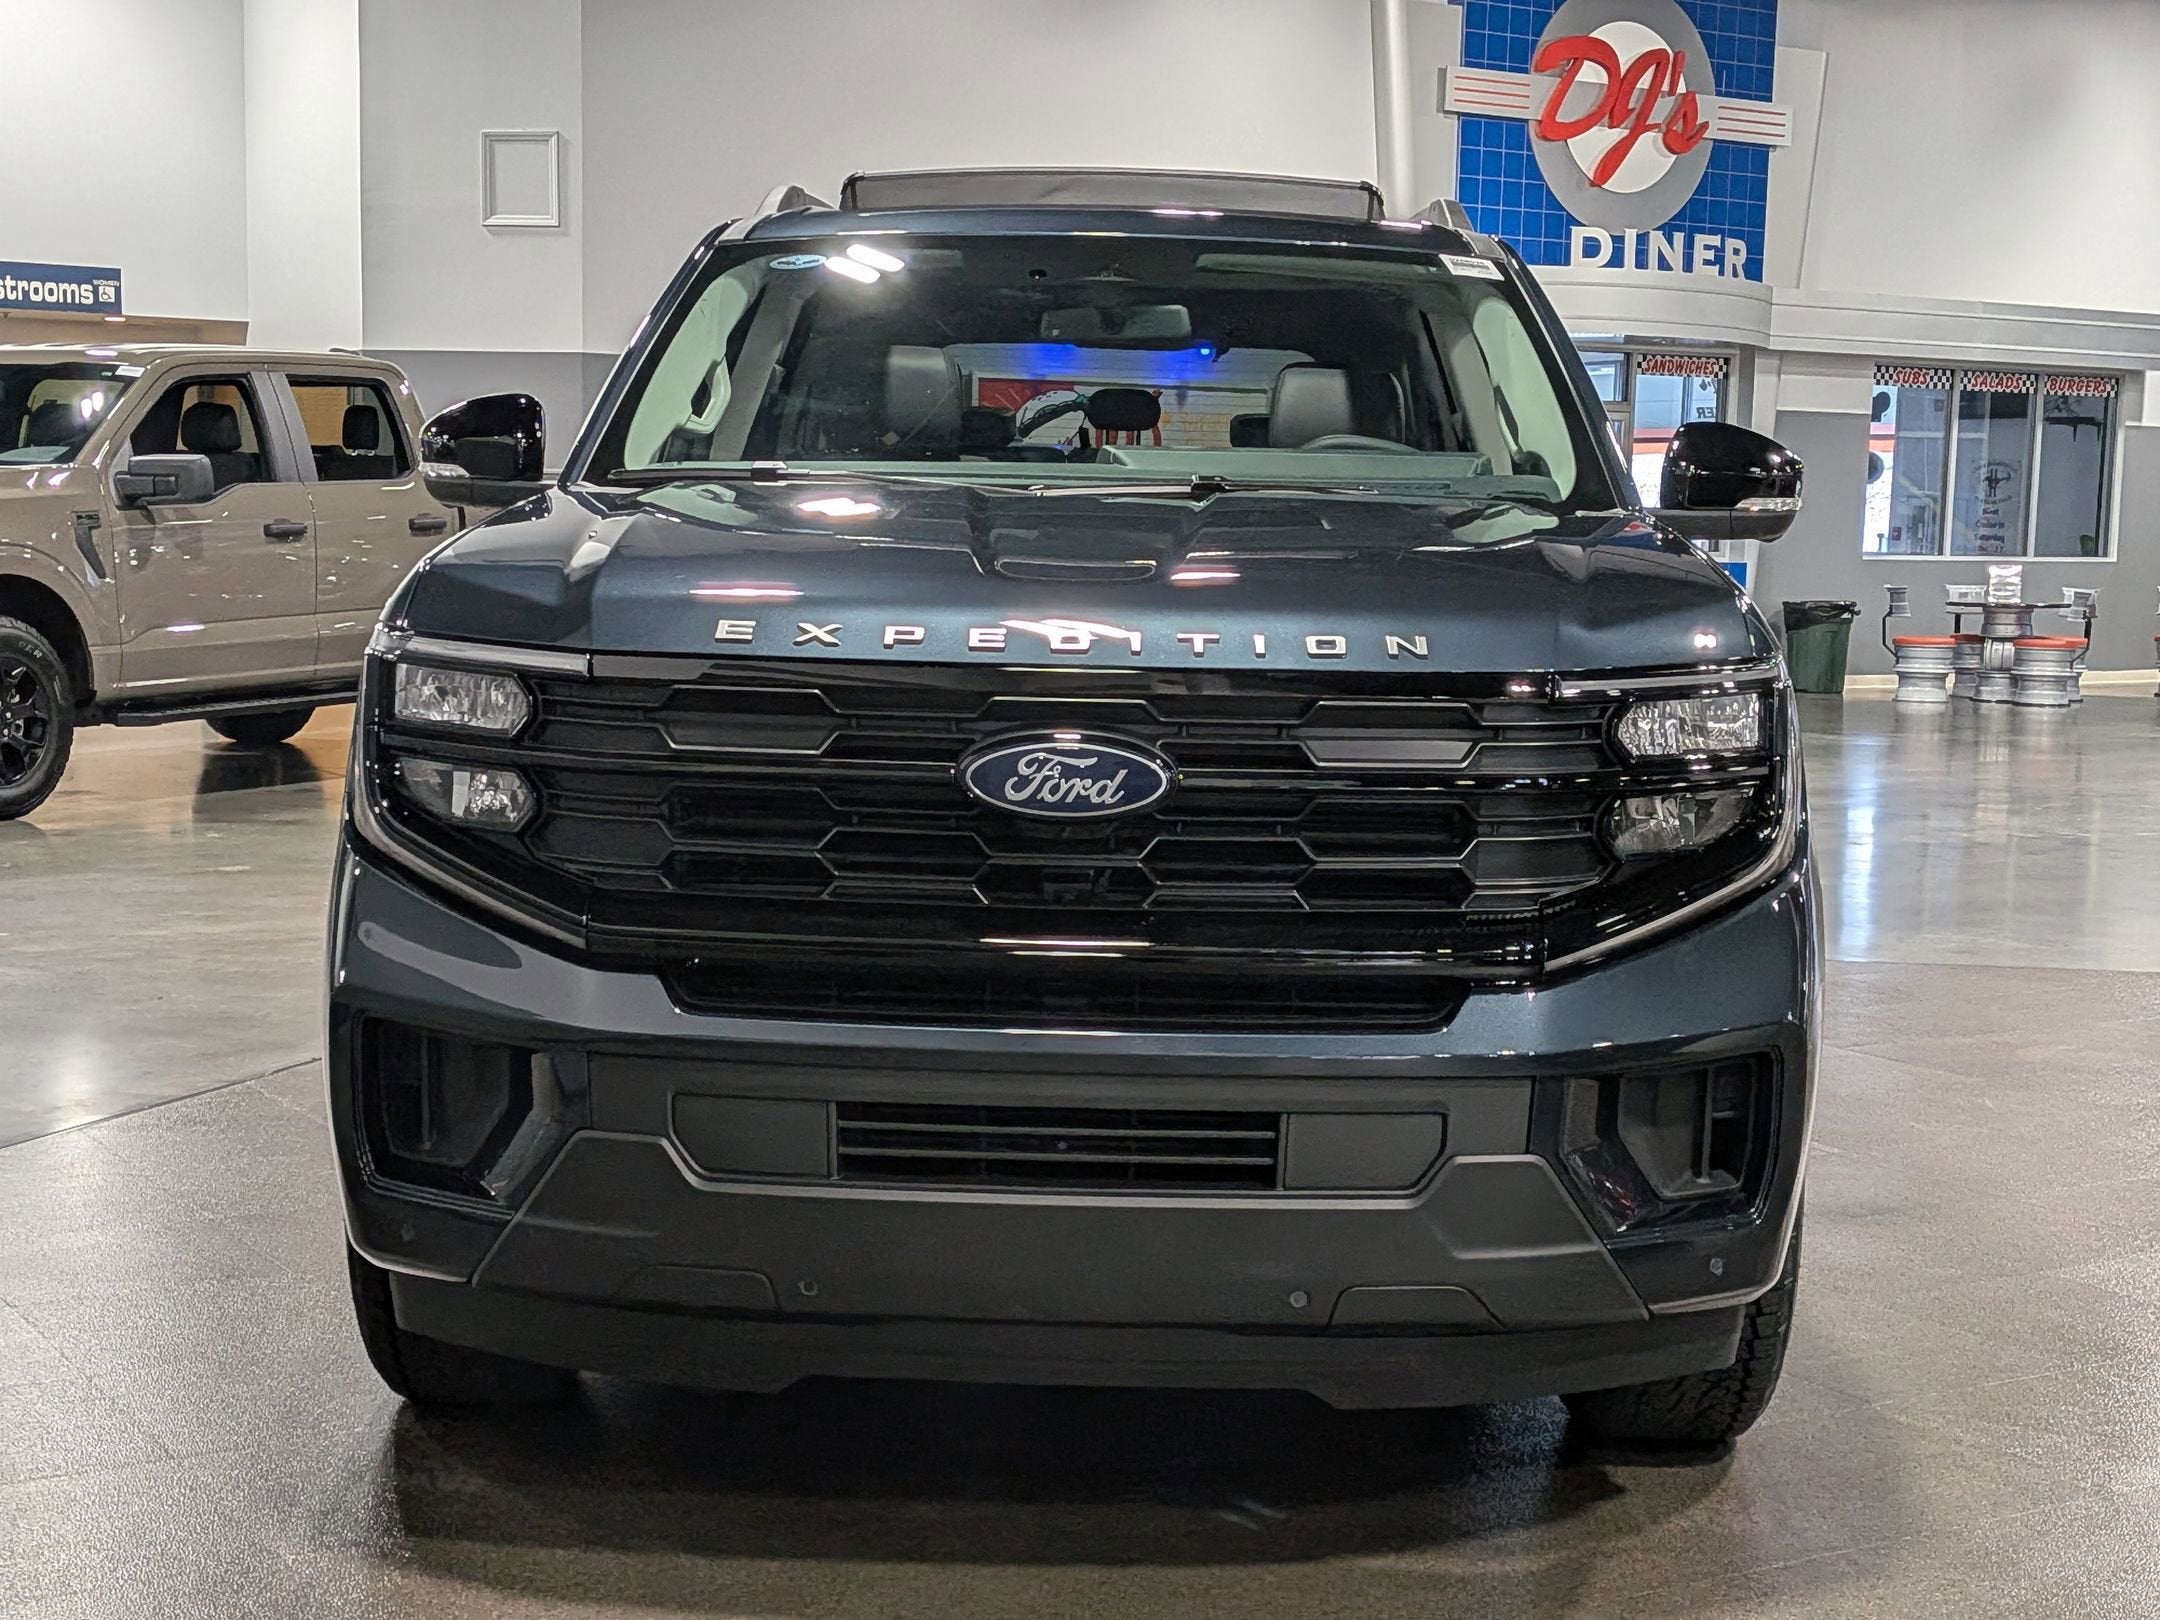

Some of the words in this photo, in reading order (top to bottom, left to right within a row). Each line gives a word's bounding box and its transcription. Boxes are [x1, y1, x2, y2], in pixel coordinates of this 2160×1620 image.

[1534, 34, 1710, 187] DJ's
[1570, 225, 1748, 280] DINER
[1644, 358, 1717, 376] SANDWICHES
[1893, 369, 1930, 386] SUBS
[1971, 374, 2024, 391] SALADS
[2049, 377, 2109, 395] BURGERS
[714, 618, 1429, 659] EXPEDITION
[1005, 752, 1128, 804] Ford
